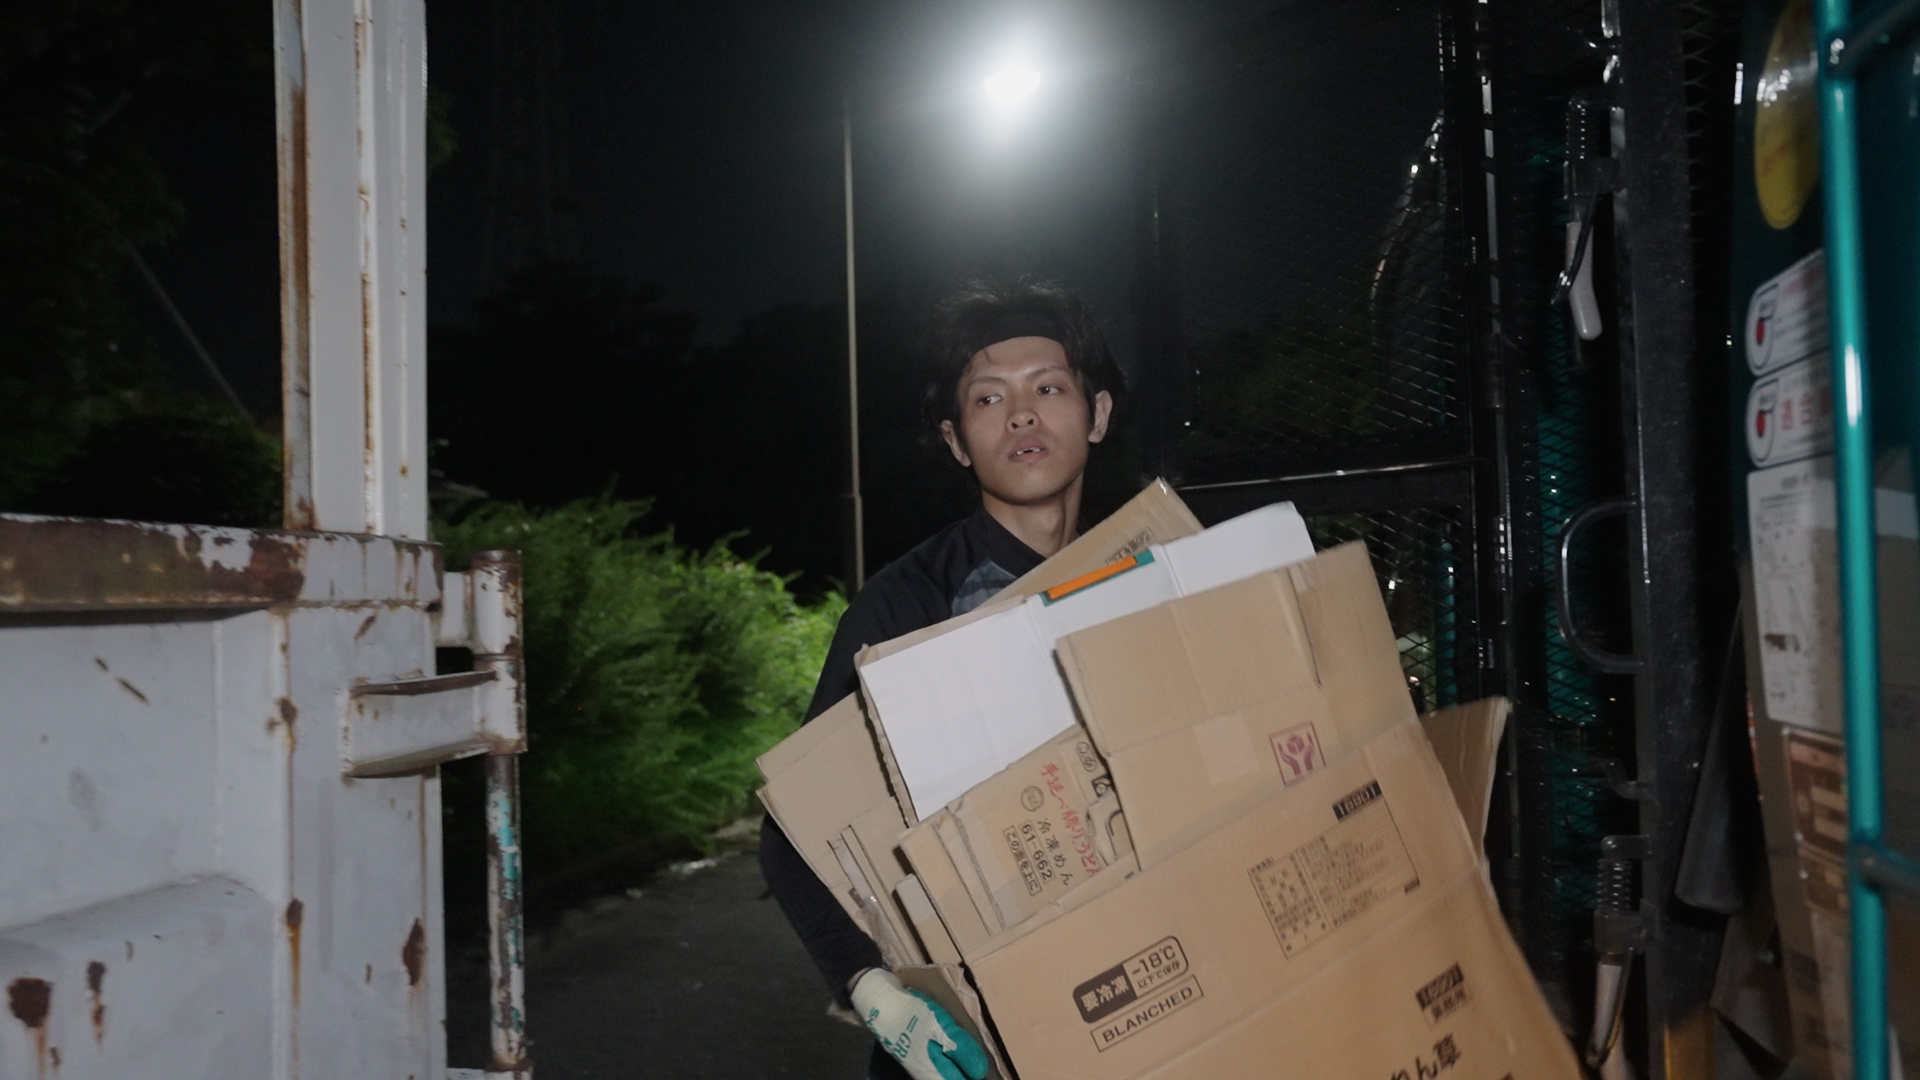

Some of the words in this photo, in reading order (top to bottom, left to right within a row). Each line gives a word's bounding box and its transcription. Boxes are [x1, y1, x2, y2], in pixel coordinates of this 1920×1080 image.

[1006, 831, 1039, 891] この面を上に
[1021, 823, 1053, 881] 61-662
[1037, 817, 1073, 886] 冷凍めん
[1102, 986, 1193, 1043] BLANCHED
